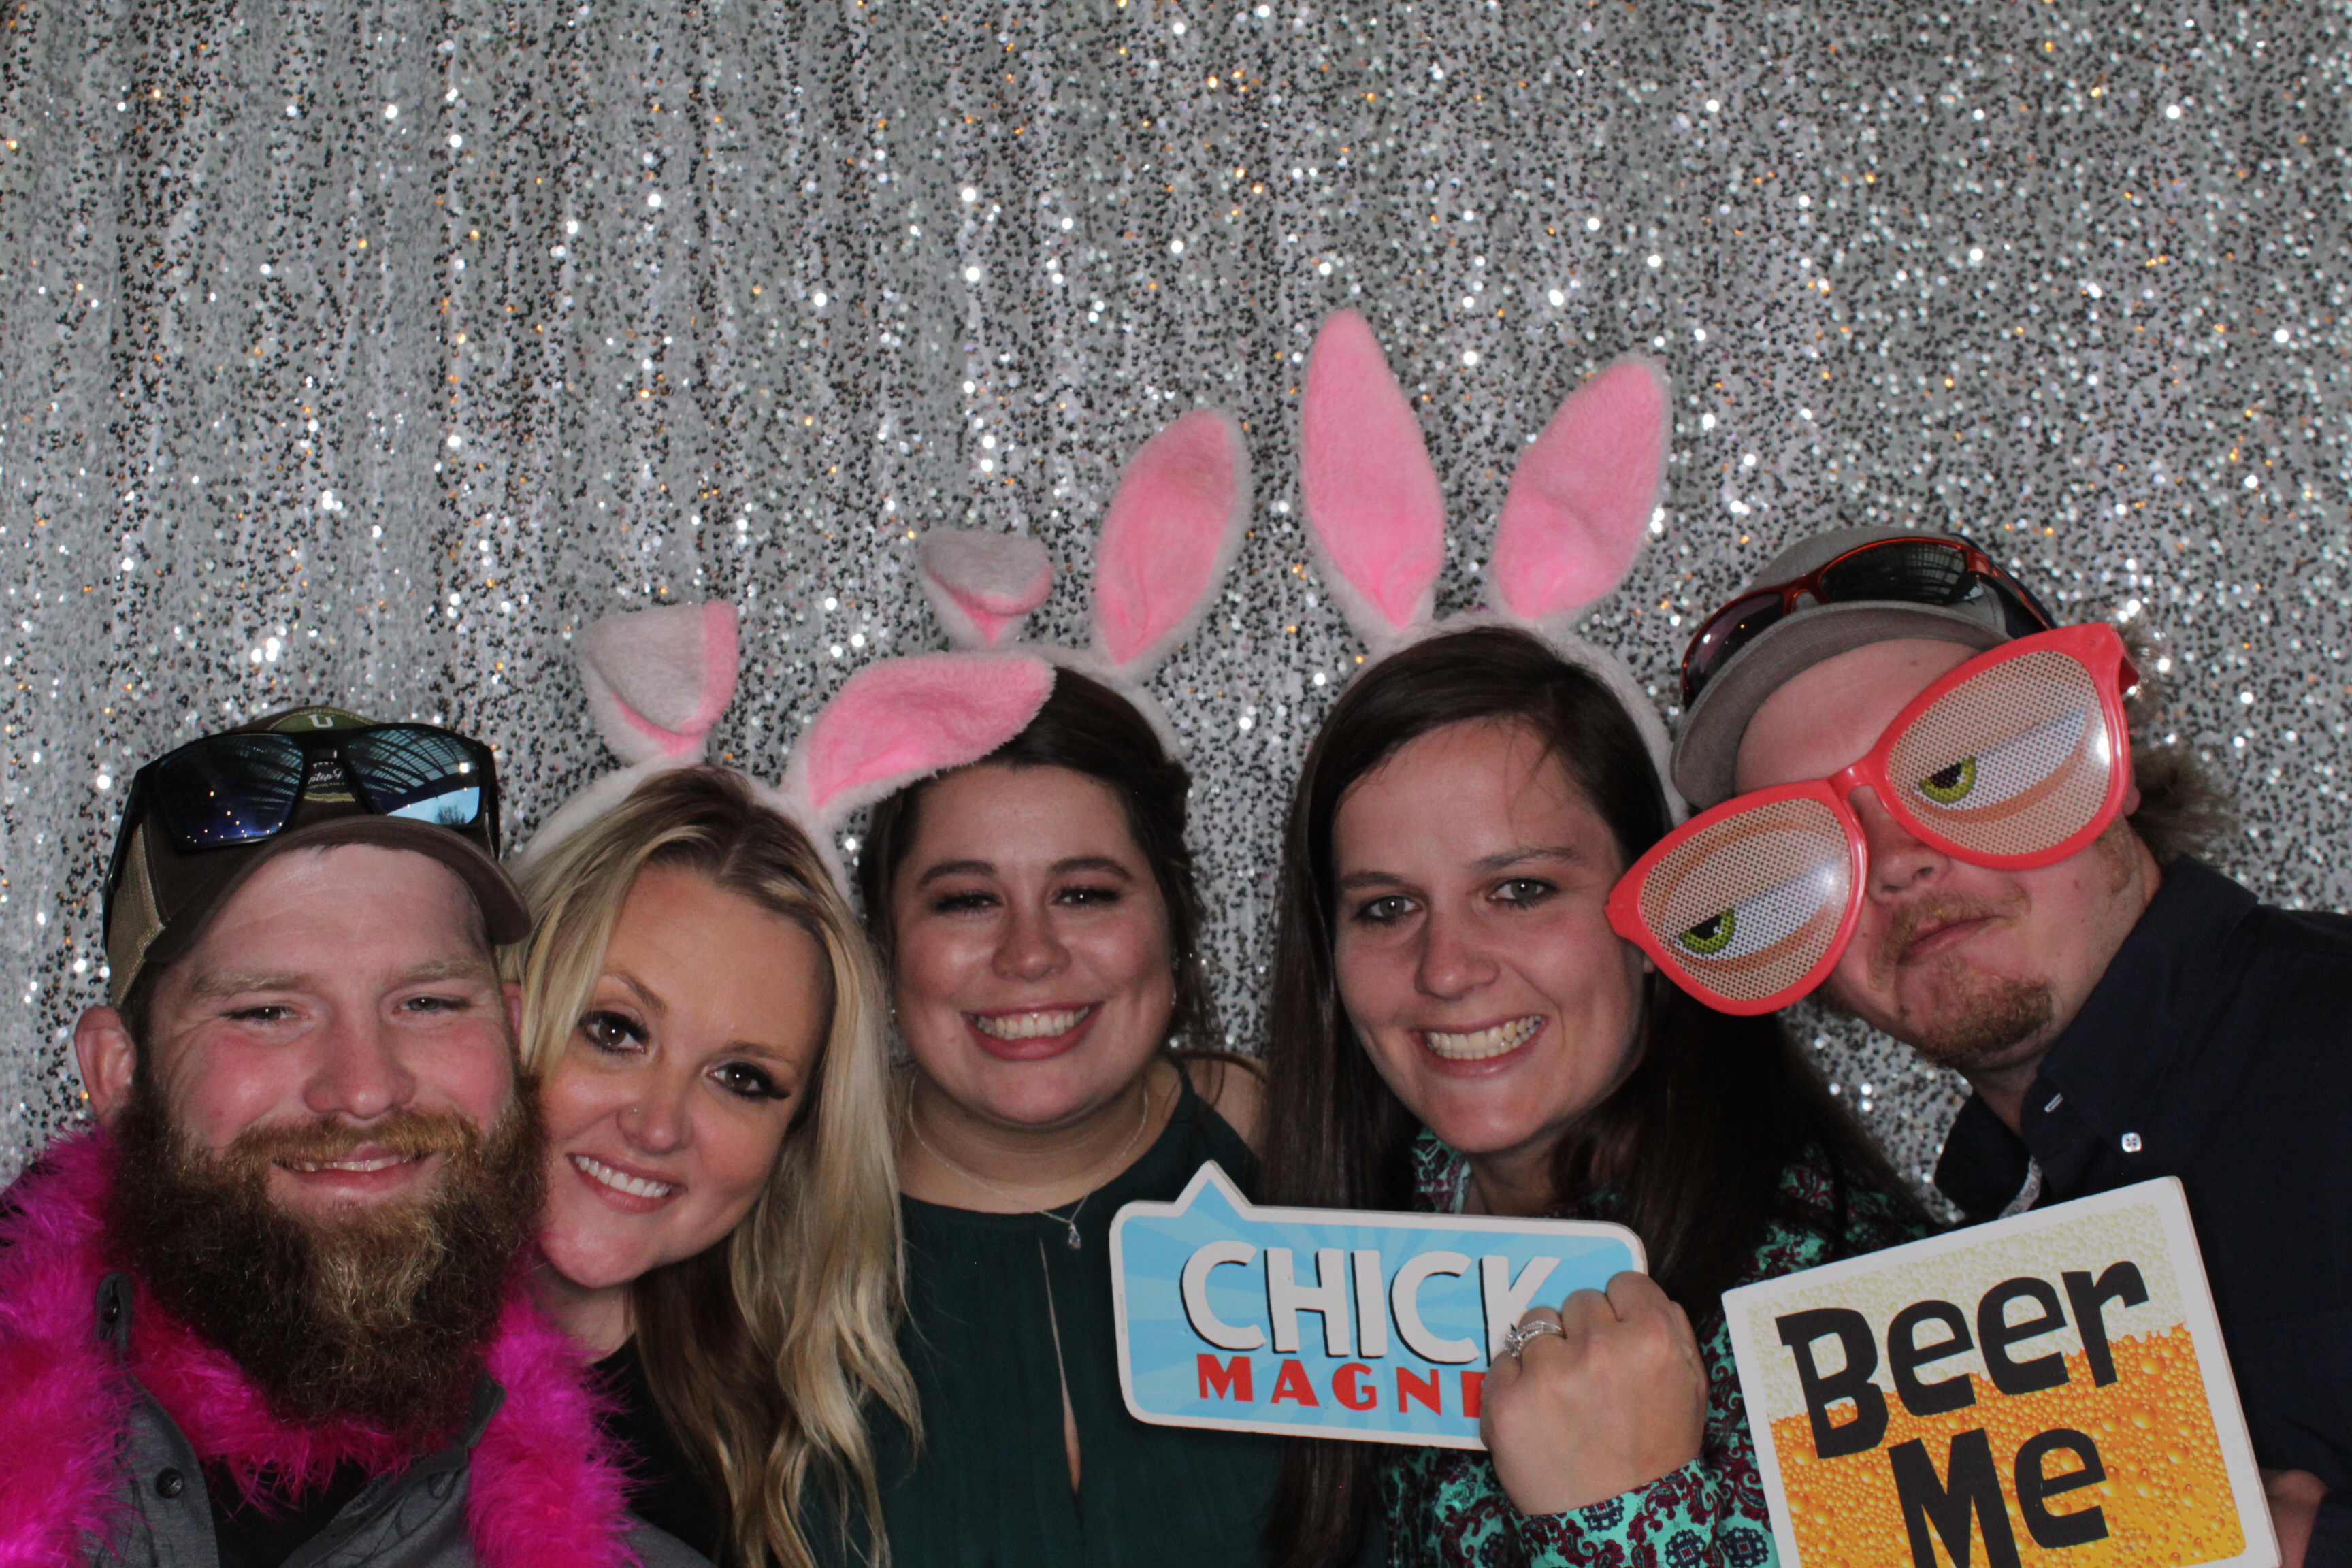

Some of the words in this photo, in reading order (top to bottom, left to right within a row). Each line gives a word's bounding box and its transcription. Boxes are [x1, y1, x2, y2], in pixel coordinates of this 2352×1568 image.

[1180, 1240, 1561, 1367] CHICK
[1775, 1261, 2149, 1459] Beer
[1888, 1427, 2110, 1568] Me
